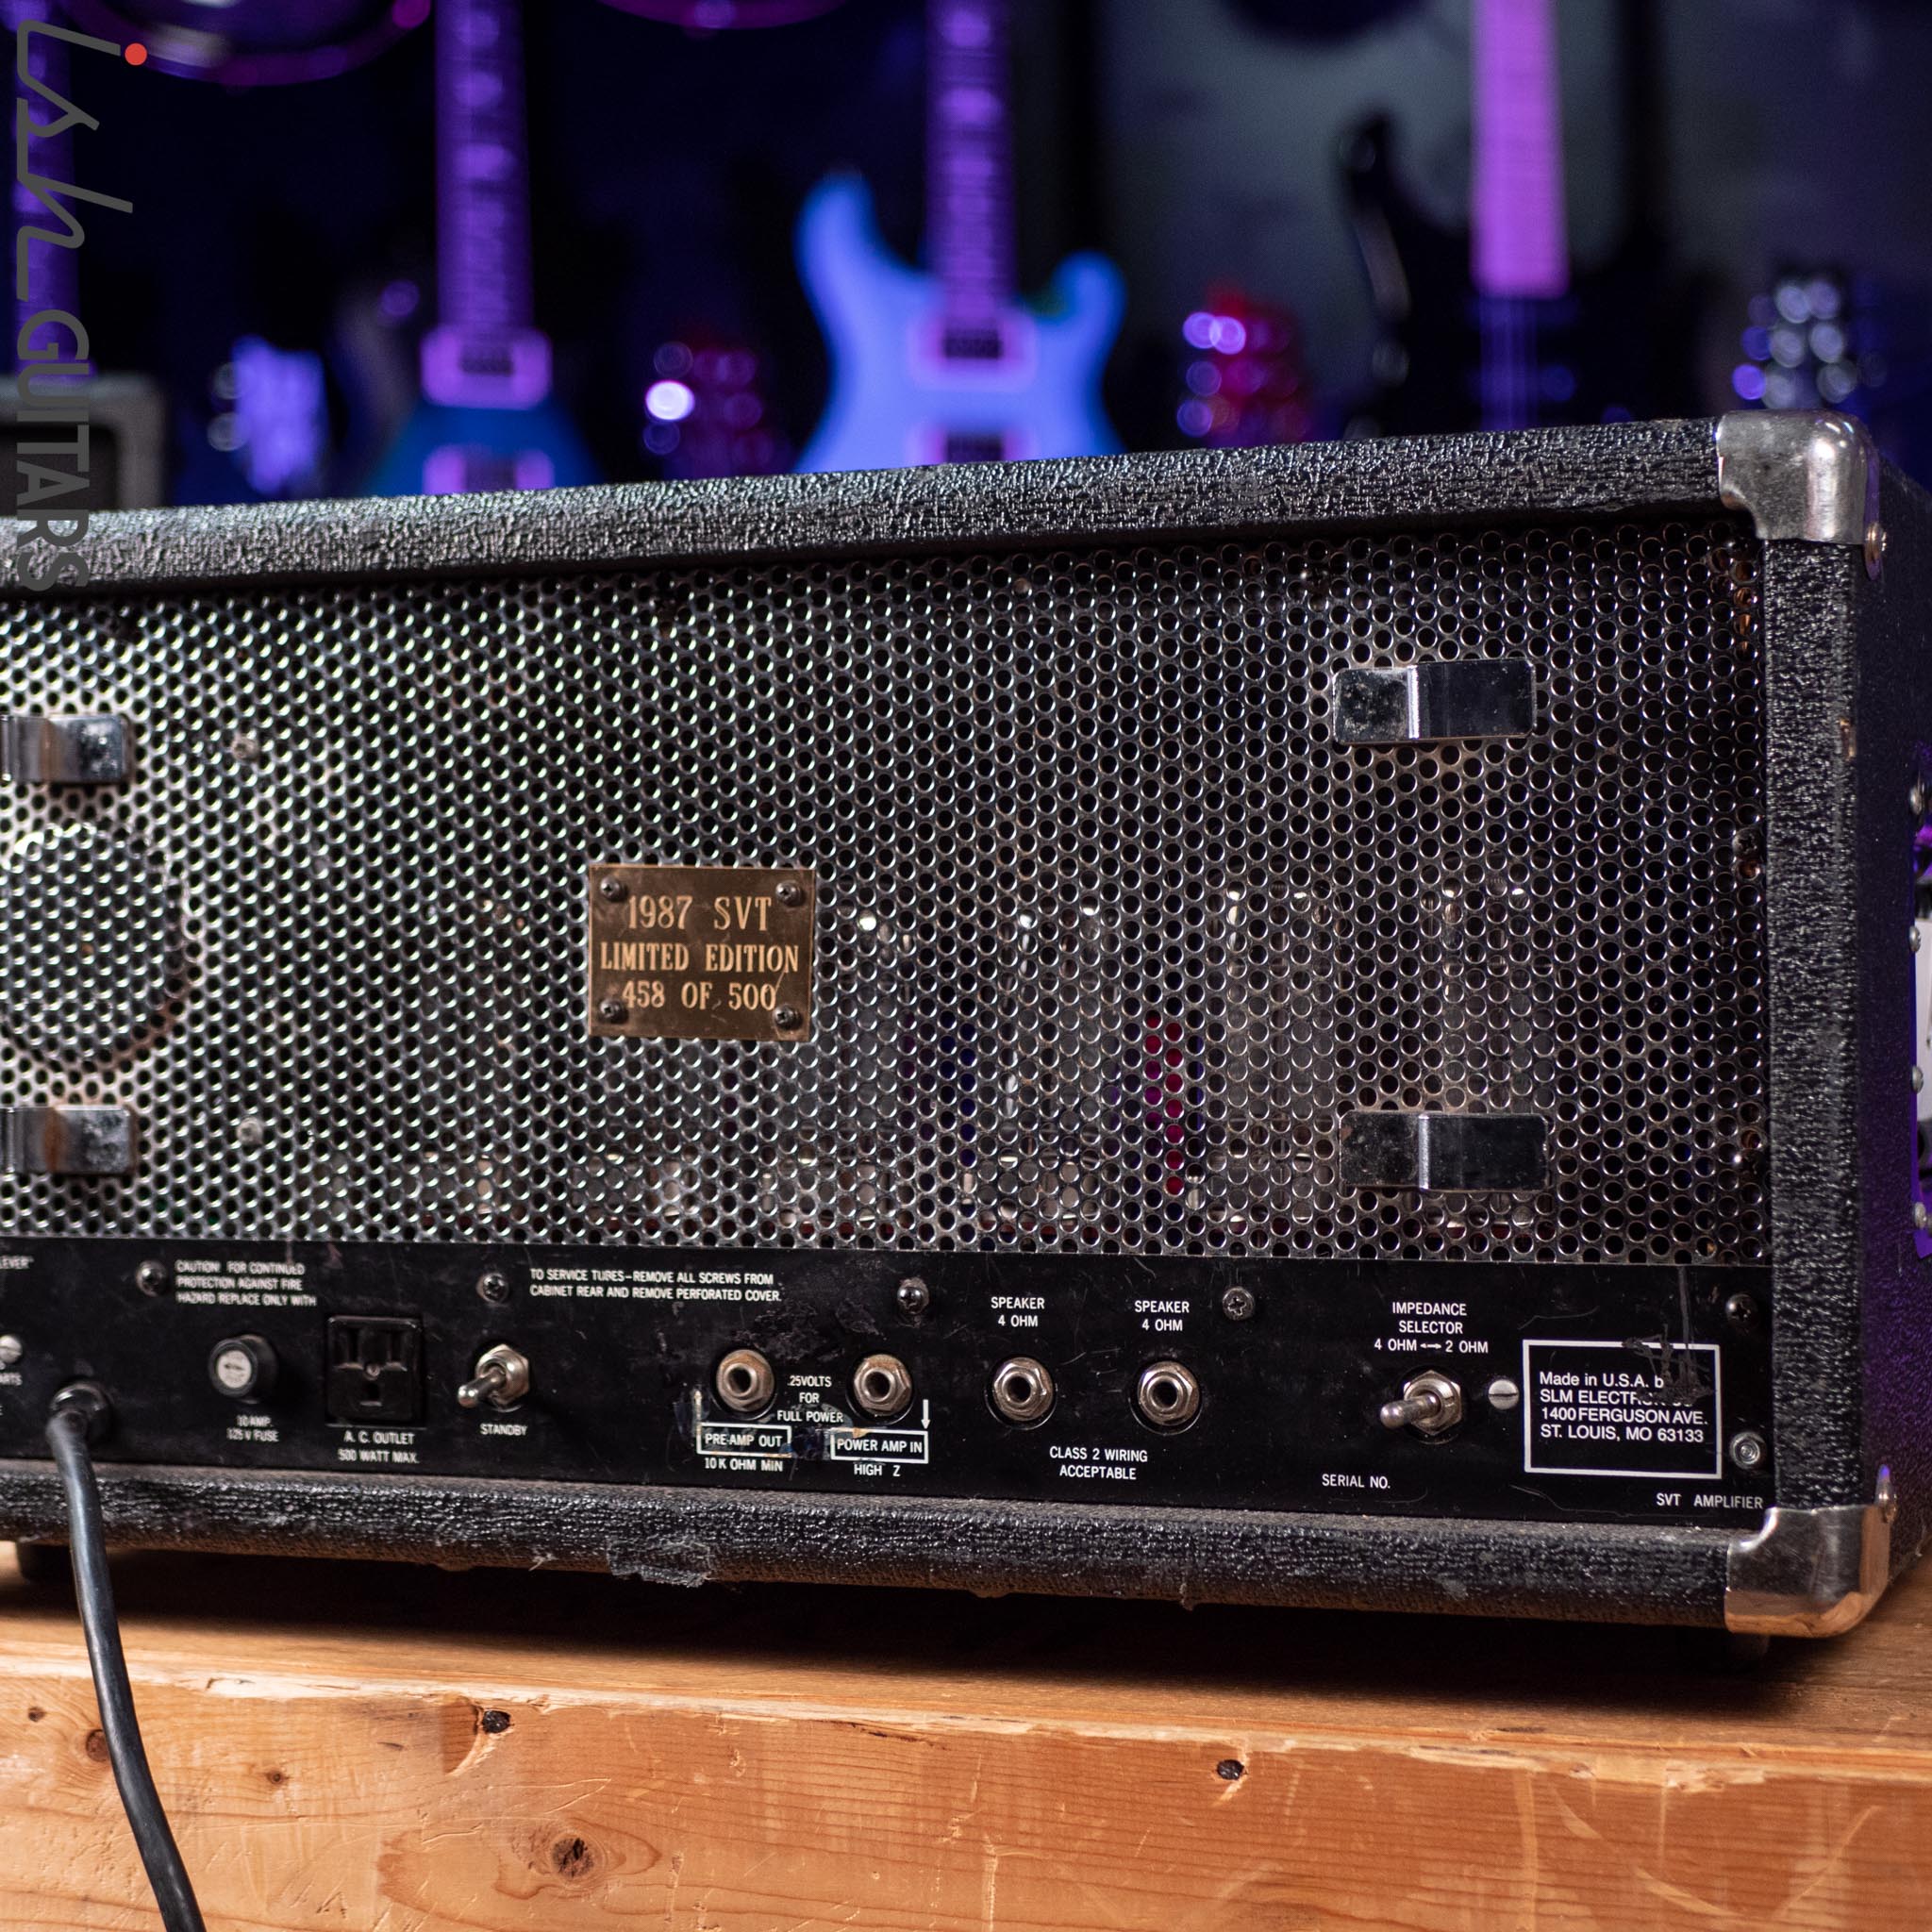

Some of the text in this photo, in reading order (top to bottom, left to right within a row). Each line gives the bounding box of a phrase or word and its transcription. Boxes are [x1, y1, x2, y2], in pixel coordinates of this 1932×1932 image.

[627, 895, 773, 931] 1987 SVT
[600, 941, 799, 973] LIMITED EDITION
[622, 980, 776, 1010] 458 OF 500
[226, 1261, 247, 1274] FOR
[248, 1262, 306, 1274] CONTINUED
[176, 1275, 303, 1291] PROTECTION AGAINST FIRE
[530, 1268, 544, 1280] TO
[547, 1269, 588, 1281] SERVICE
[677, 1272, 695, 1283] ALL
[699, 1273, 741, 1284] SCREWS
[744, 1274, 774, 1285] FROM
[176, 1291, 317, 1307] HAZARD REPLACE ONLY WITH
[529, 1285, 782, 1302] CABINET REAR AND REMOVE PERFORATED COVER.
[991, 1297, 1045, 1309] SPEAKER
[1135, 1301, 1190, 1313] SPEAKER
[1392, 1302, 1467, 1316] IMPEDANCE
[998, 1315, 1038, 1327] 4 OHM
[1142, 1319, 1183, 1331] 4 OHM
[1399, 1320, 1463, 1335] SELECTOR
[1374, 1339, 1489, 1354] 4 OHM 2 OHM
[1540, 1372, 1580, 1386] Made
[1585, 1373, 1597, 1386] in
[1603, 1374, 1649, 1387] U.S.A.
[799, 1392, 819, 1404] FOR
[1540, 1390, 1574, 1403] SLM
[776, 1410, 843, 1423] FULL POWER
[1542, 1407, 1707, 1425] 1400 FERGUSON AVE.
[253, 1430, 279, 1442] FUSE
[480, 1424, 527, 1436] STANDBY
[1541, 1424, 1704, 1442] ST. LOUIS, MO 63133
[373, 1432, 415, 1444] OUTLET
[705, 1434, 782, 1447] PRE-AMP OUT
[837, 1439, 923, 1453] POWER AMP IN
[359, 1450, 391, 1462] WATT
[1050, 1446, 1148, 1462] CLASS 2 WIRING
[729, 1457, 756, 1471] OHM
[760, 1459, 783, 1472] MIN
[854, 1463, 900, 1476] HIGH Z
[1059, 1465, 1137, 1480] ACCEPTABLE
[1322, 1474, 1391, 1489] SERIAL NO.
[1657, 1493, 1763, 1509] SVT AMPLIFIER
